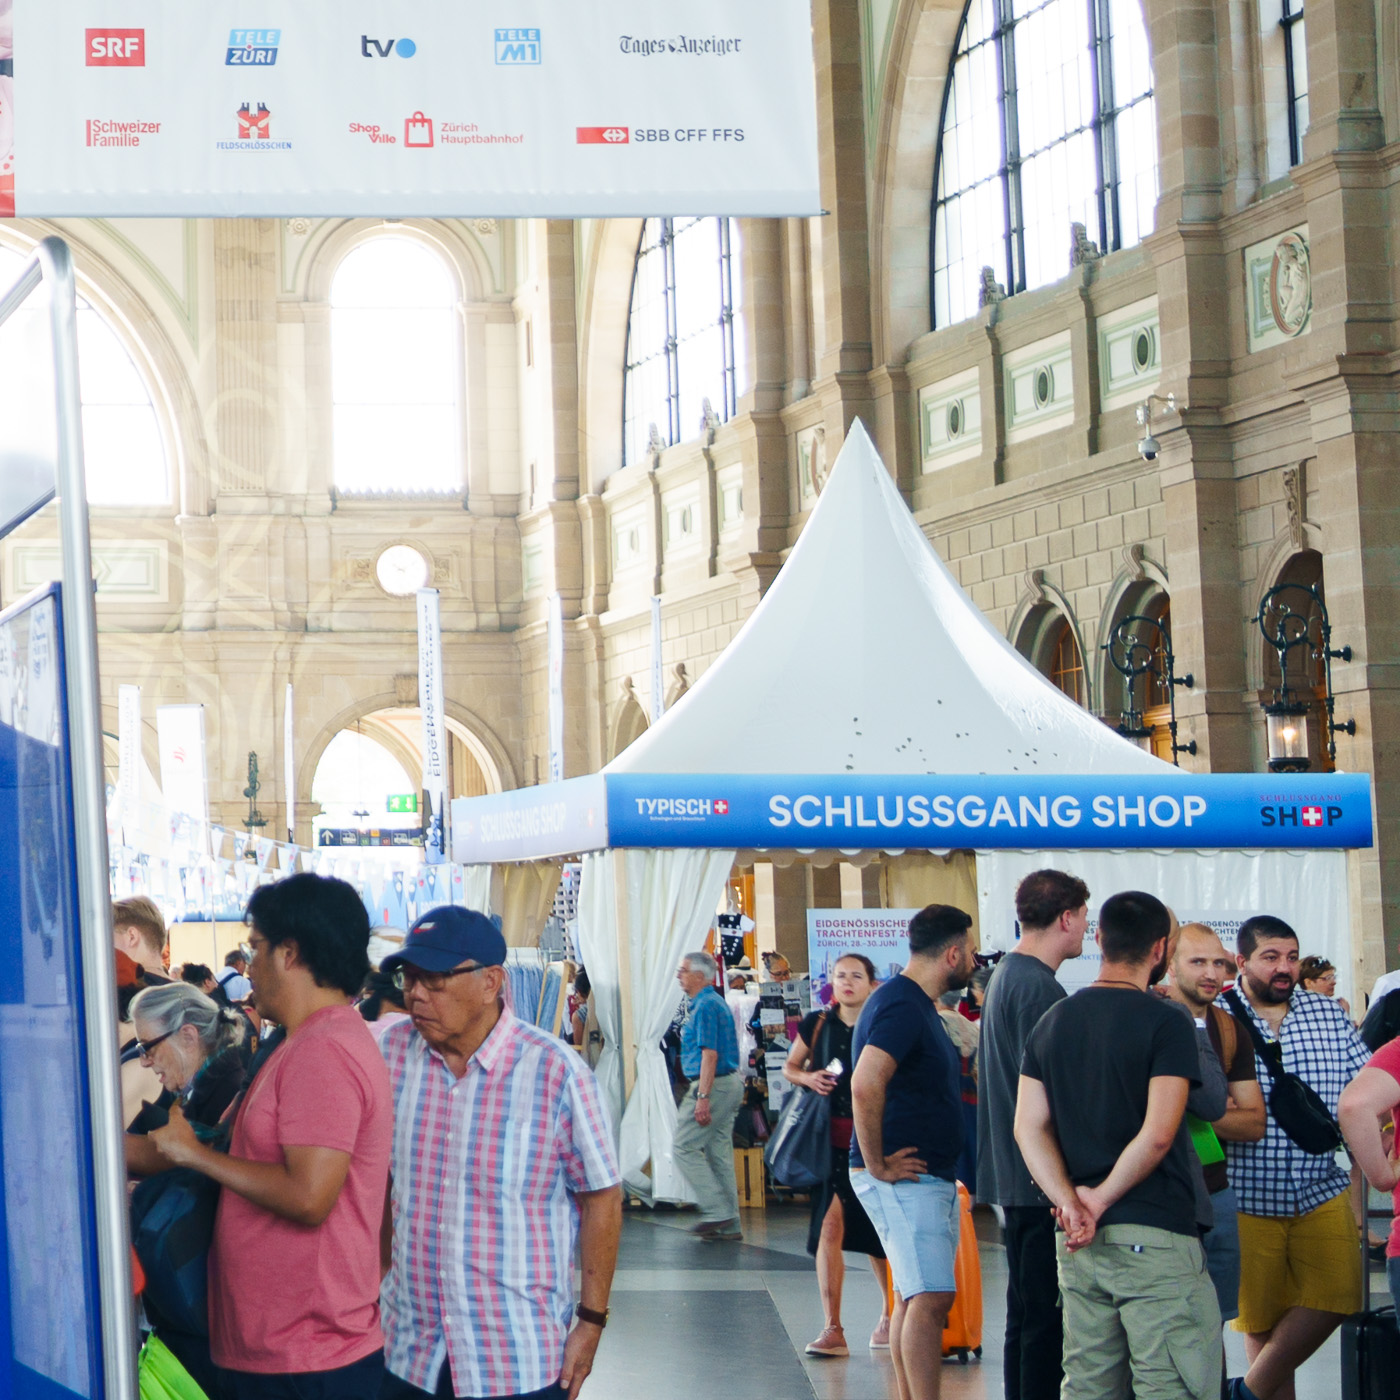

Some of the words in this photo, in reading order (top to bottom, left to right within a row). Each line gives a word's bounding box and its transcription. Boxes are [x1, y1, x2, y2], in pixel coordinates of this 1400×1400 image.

[235, 31, 275, 43] TELE
[498, 30, 537, 41] TELE
[91, 37, 139, 58] SRF
[500, 43, 538, 61] M1
[93, 119, 161, 134] Schweizer
[349, 122, 380, 137] Shop
[441, 121, 478, 133] Zürich
[93, 132, 140, 147] Familie
[369, 134, 397, 144] Ville
[441, 133, 525, 145] Hauptbahnhof
[635, 129, 670, 142] SBB
[674, 129, 707, 142] CFF
[713, 129, 745, 142] FFS
[216, 141, 292, 150] FELDSCHLÖSSCHEN
[635, 798, 711, 815] TYPISCH
[768, 794, 1081, 828] SCHLUSSGANG
[1092, 794, 1207, 828] SHOP
[480, 806, 540, 844] SCHLUSSGANG
[540, 801, 566, 834] SHOP
[816, 930, 897, 938] TRACHTENFEST
